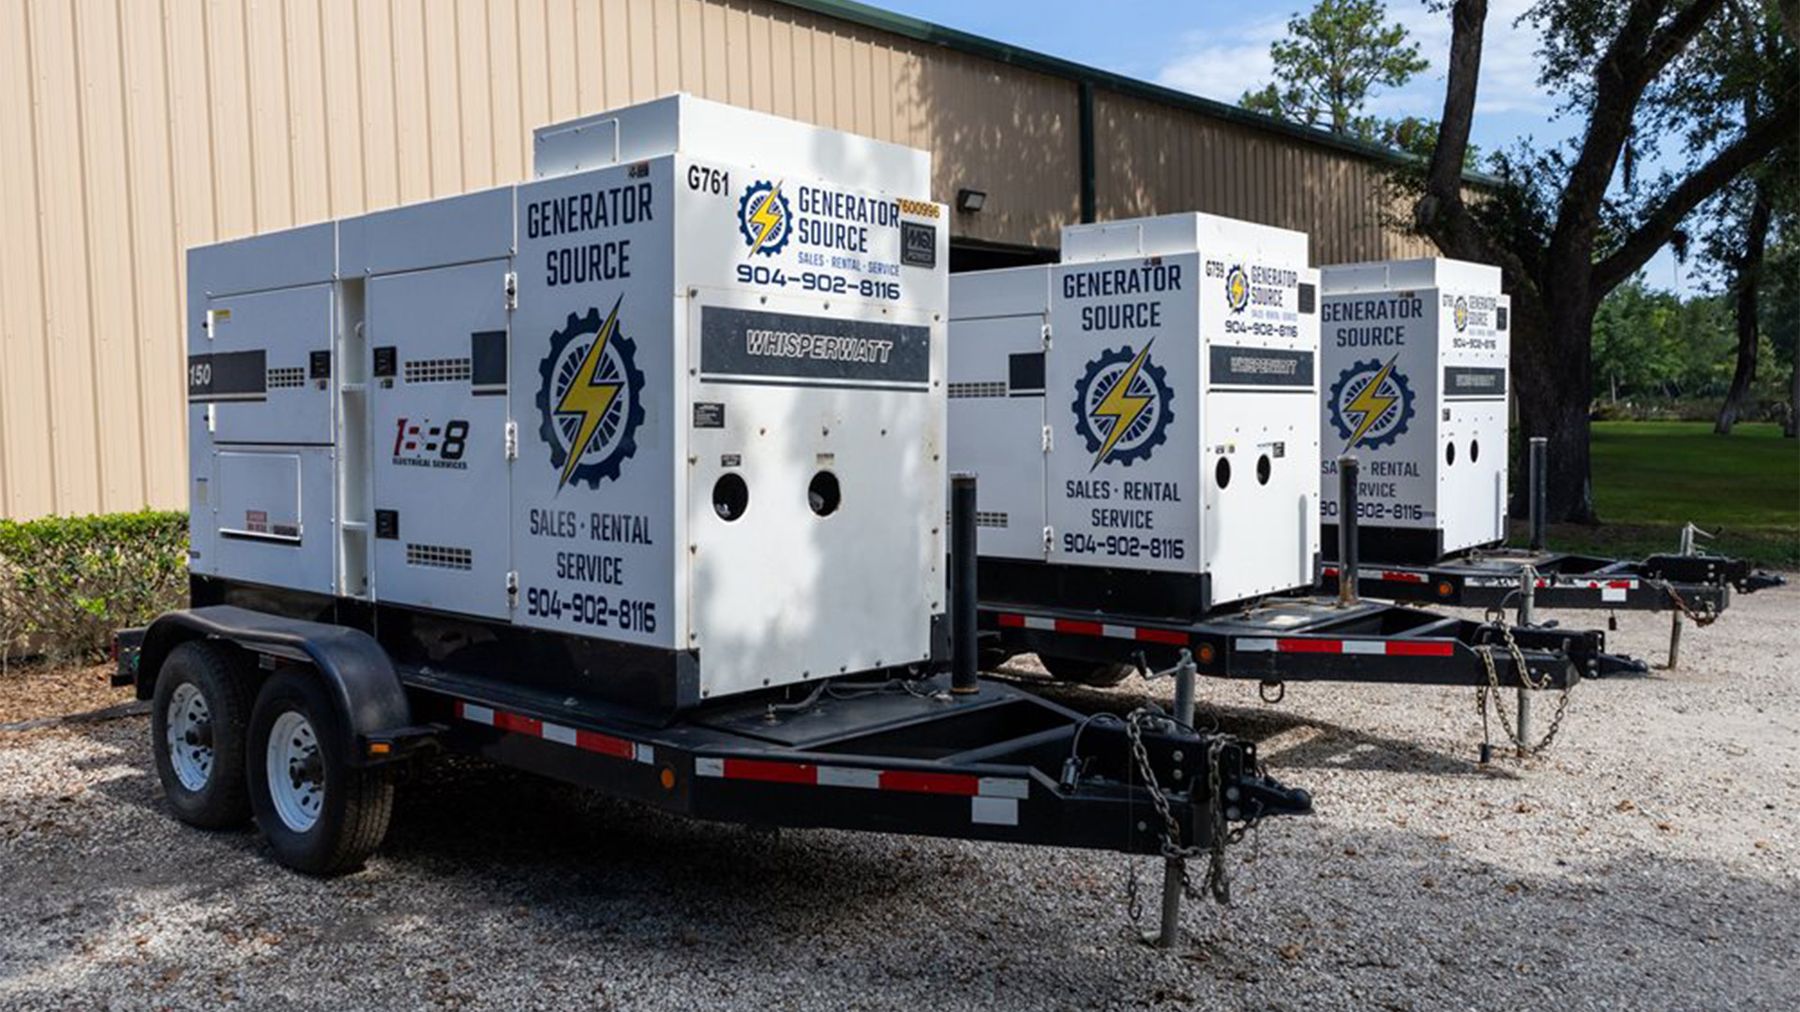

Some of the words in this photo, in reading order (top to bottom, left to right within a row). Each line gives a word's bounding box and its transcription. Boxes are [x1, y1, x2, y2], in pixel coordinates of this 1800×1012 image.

[687, 164, 730, 197] G761
[527, 182, 653, 239] GENERATOR
[798, 186, 900, 229] GENERATOR
[798, 218, 868, 253] SOURCE
[546, 240, 631, 287] SOURCE
[797, 251, 825, 268] SALES
[831, 256, 862, 273] RENTAL
[867, 261, 900, 277] SERVICE
[1250, 264, 1298, 290] GENERATOR
[736, 263, 901, 301] 904-902-8116
[1063, 264, 1182, 299] GENERATOR
[1081, 301, 1162, 332] SOURCE
[1321, 298, 1424, 323] GENERATOR
[745, 329, 894, 364] WHISPERWATT
[1336, 325, 1406, 348] SOURCE
[189, 363, 212, 386] 150
[1370, 461, 1421, 478] RENTAL
[1066, 480, 1111, 500] SALES
[1123, 481, 1182, 502] RENTAL
[529, 508, 577, 539] SALES
[590, 512, 653, 546] RENTAL
[1091, 508, 1154, 530] SERVICE
[1063, 532, 1185, 560] 904-902-8116
[556, 551, 624, 586] SERVICE
[527, 586, 657, 634] 904-902-8116
